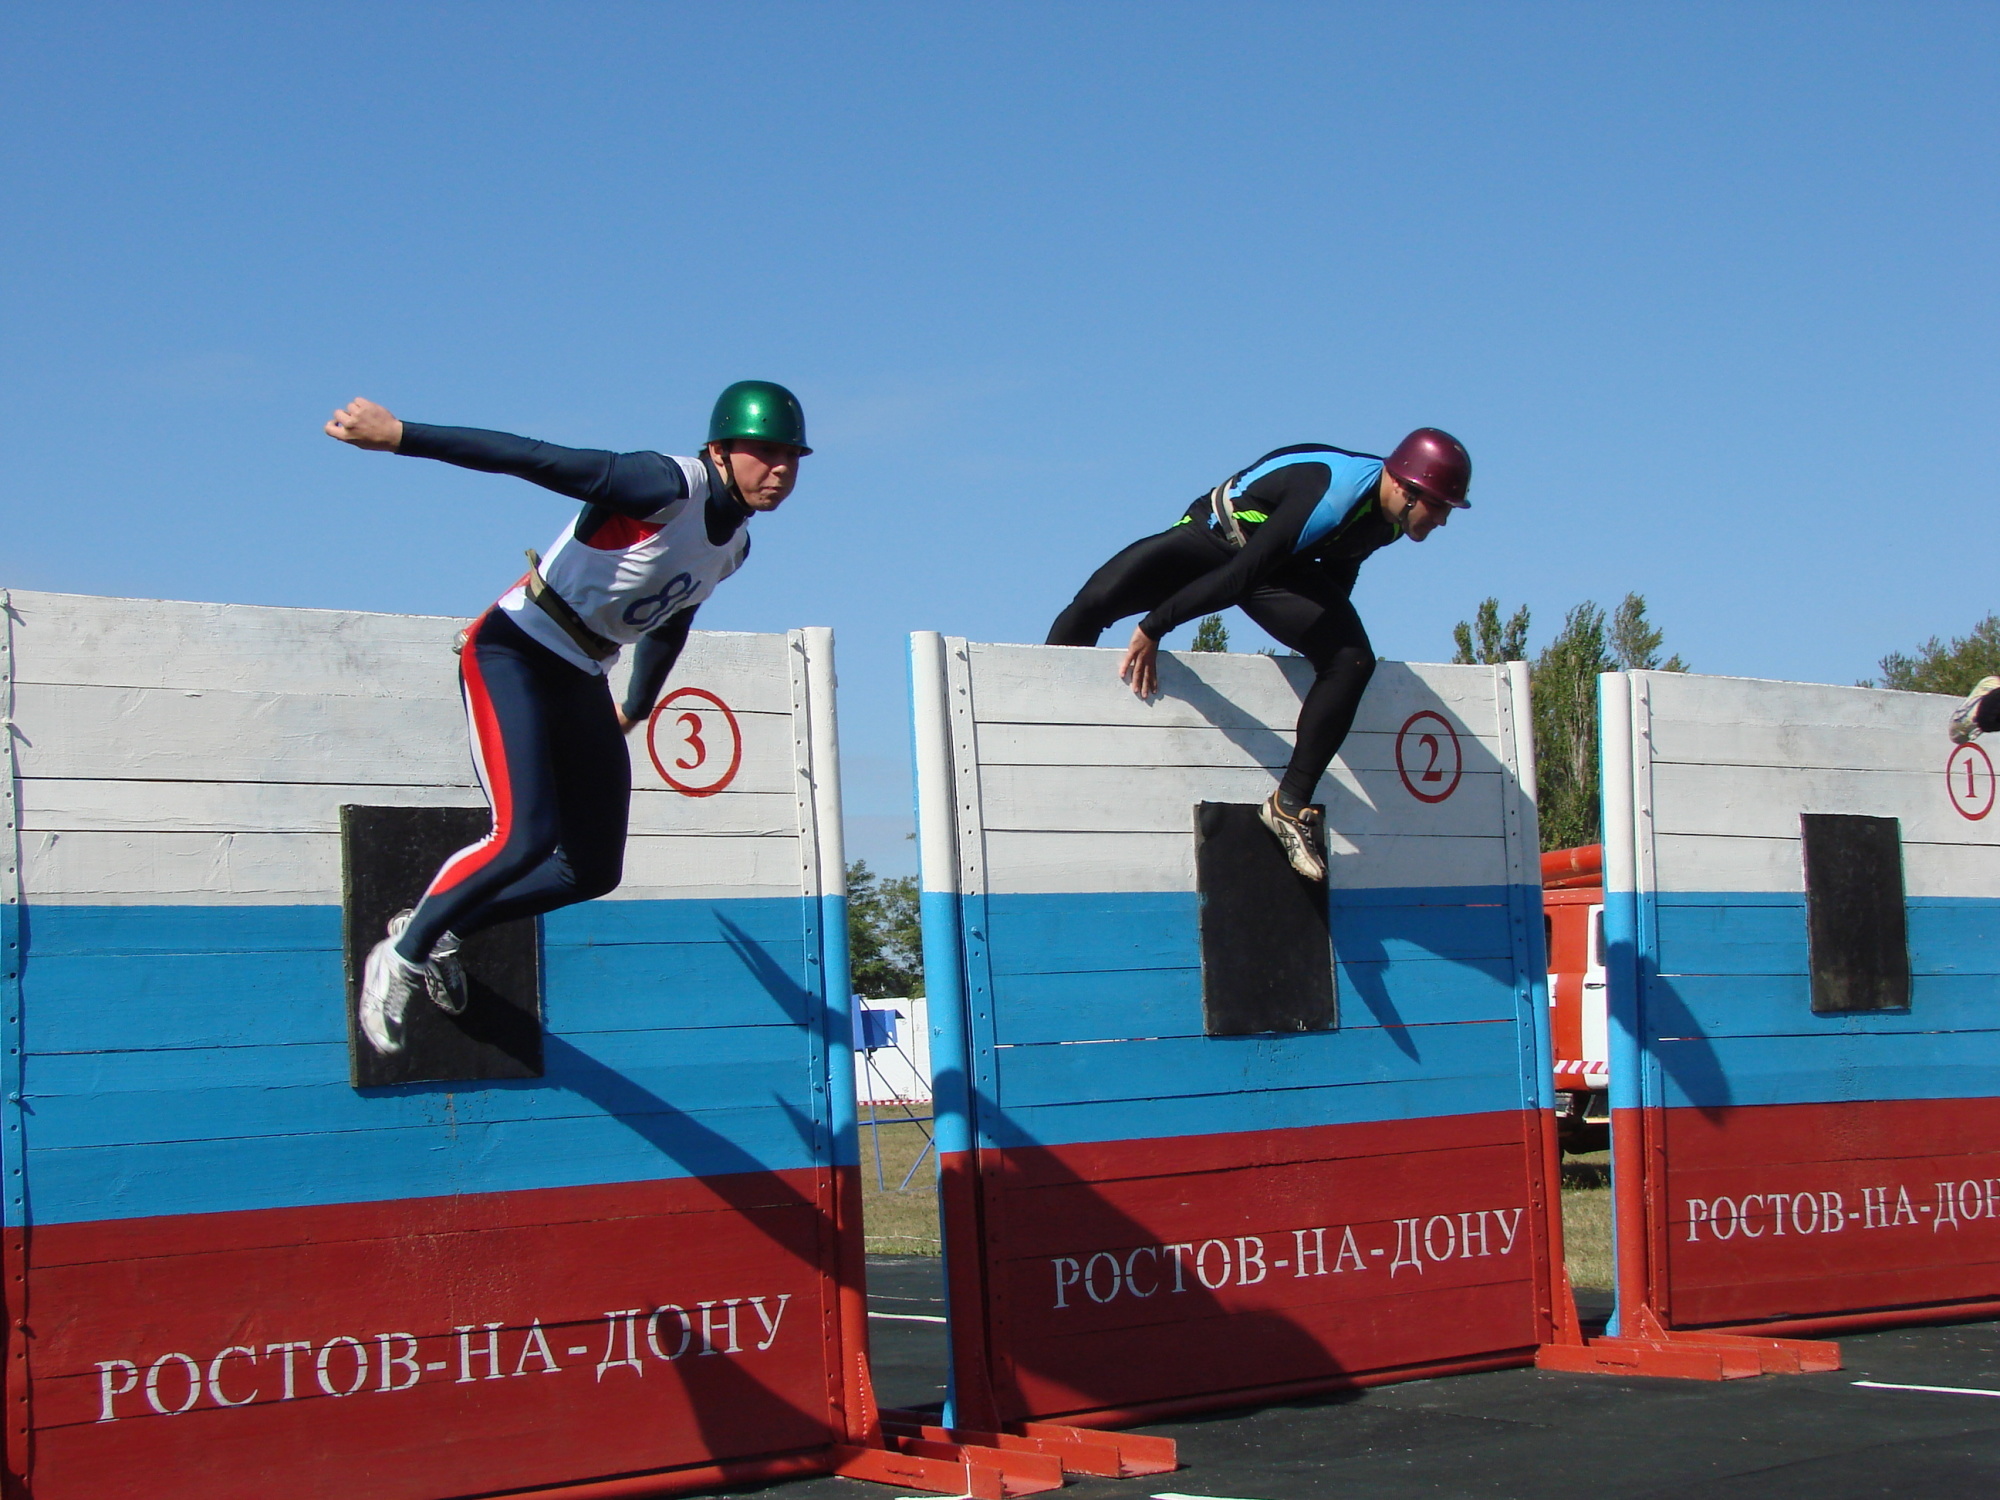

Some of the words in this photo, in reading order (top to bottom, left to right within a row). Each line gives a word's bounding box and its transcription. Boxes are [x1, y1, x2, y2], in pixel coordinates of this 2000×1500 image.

[675, 712, 706, 770] 3
[1418, 733, 1443, 782] 2
[1962, 757, 1978, 798] 1
[1050, 1207, 1524, 1309] РОСТОВ-НА-ДОНУ
[95, 1293, 792, 1423] РОСТОВ-НА-ДОНУ
